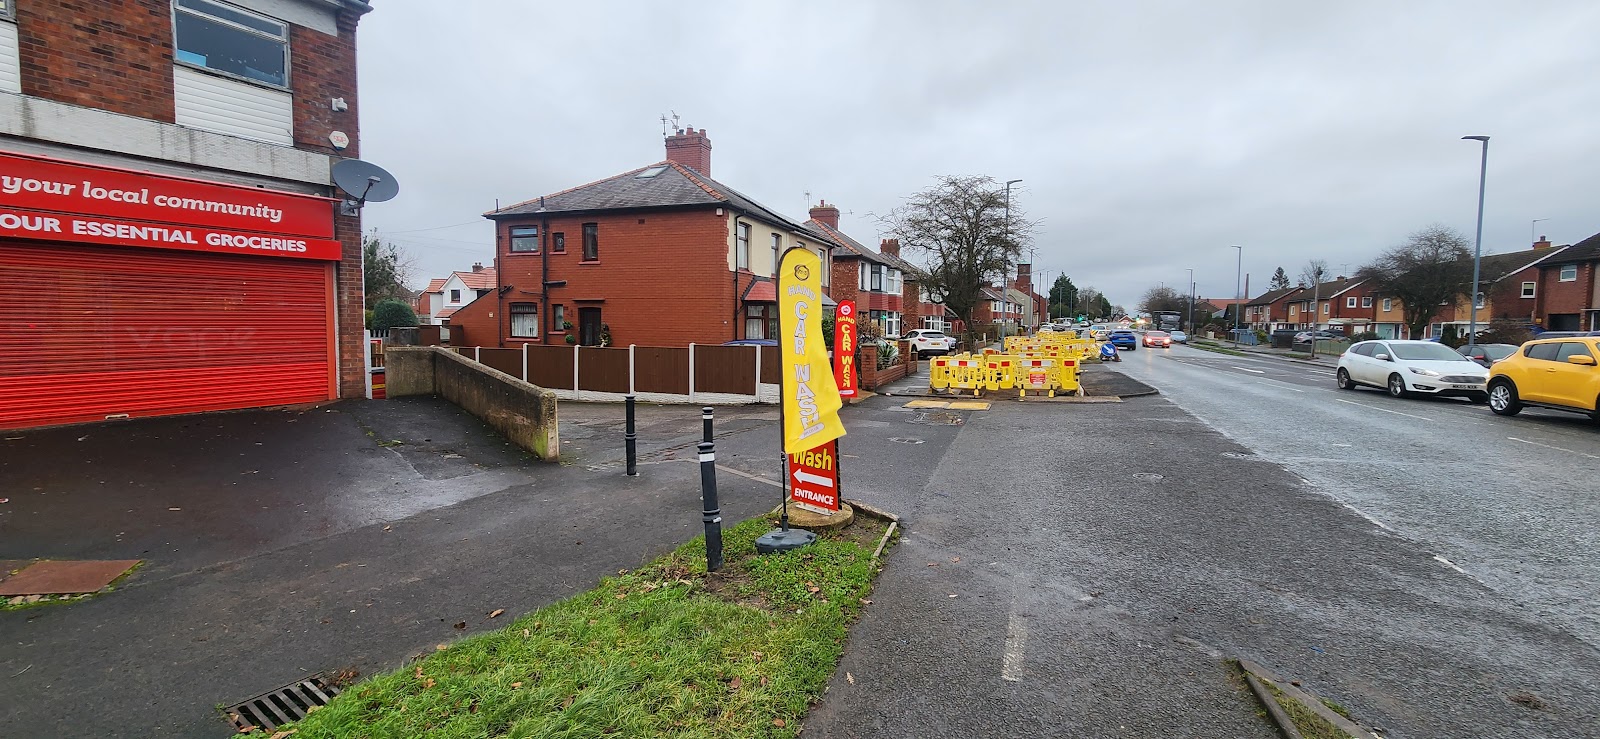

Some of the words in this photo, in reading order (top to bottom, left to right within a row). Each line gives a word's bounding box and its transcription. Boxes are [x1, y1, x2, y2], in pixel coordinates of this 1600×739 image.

[1, 175, 77, 196] your
[82, 181, 149, 205] local
[153, 192, 283, 223] community
[0, 213, 62, 233] OUR
[72, 220, 198, 244] ESSENTIAL
[205, 233, 307, 253] GROCERIES
[787, 284, 816, 301] HAND
[793, 301, 809, 355] CAR
[837, 316, 855, 325] HAND
[841, 324, 852, 351] CAR
[792, 448, 832, 471] Wash
[794, 488, 834, 506] ENTRANCE
